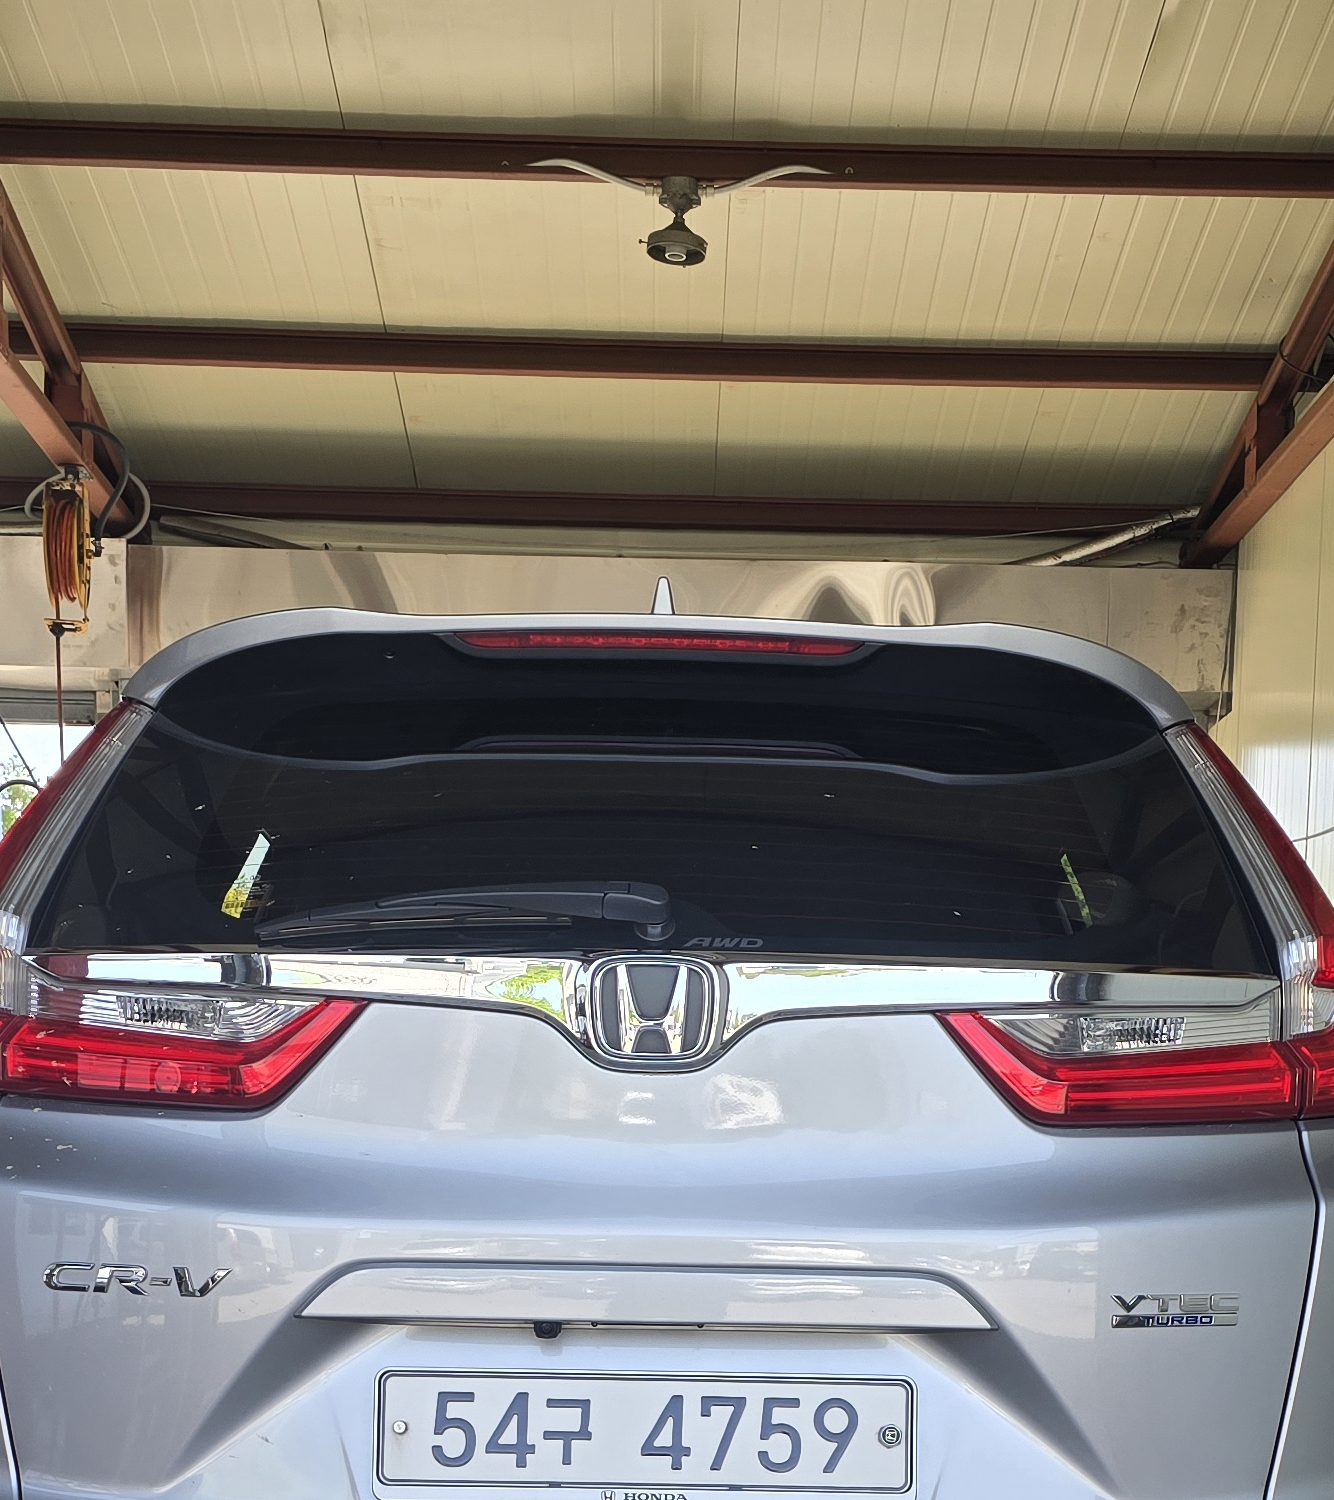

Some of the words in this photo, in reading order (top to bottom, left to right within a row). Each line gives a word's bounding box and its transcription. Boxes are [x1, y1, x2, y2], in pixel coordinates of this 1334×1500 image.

[683, 937, 763, 948] AWD
[43, 1261, 233, 1298] CR-V
[1110, 1292, 1241, 1313] VTEC
[1141, 1315, 1214, 1327] TURBO
[431, 1391, 593, 1468] 54구
[641, 1395, 859, 1474] 4759
